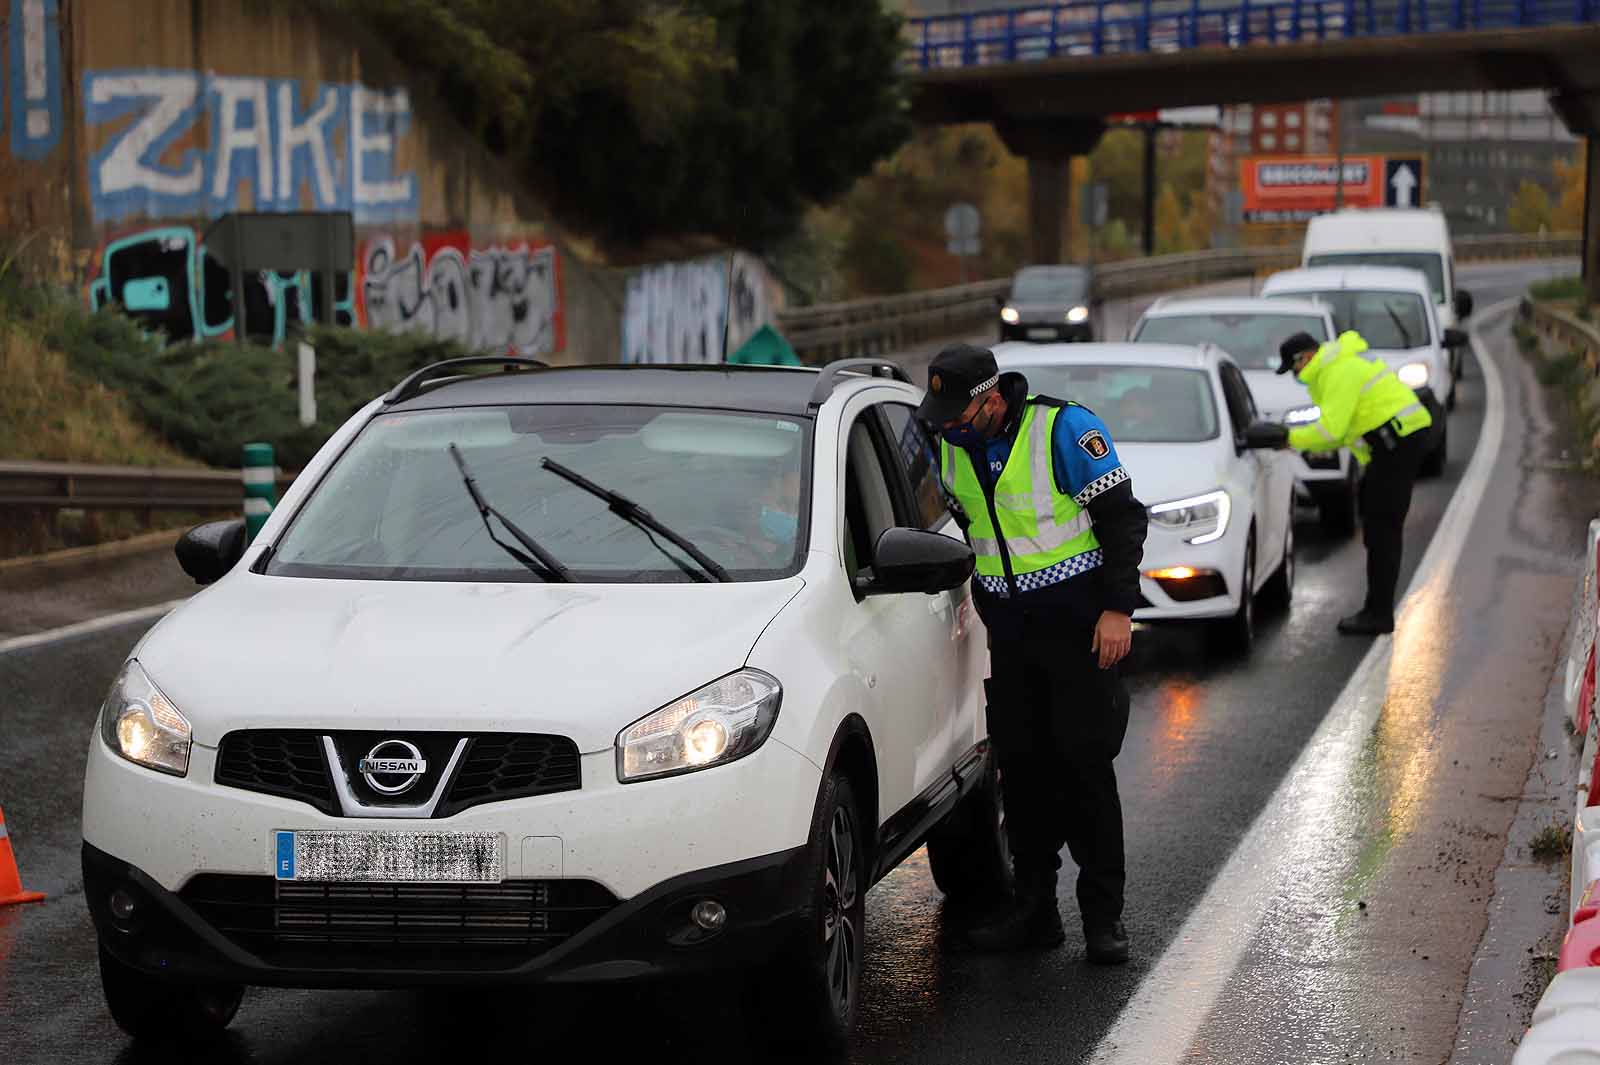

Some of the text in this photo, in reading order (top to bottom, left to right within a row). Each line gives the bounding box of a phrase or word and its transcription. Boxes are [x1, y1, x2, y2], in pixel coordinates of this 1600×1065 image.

[89, 71, 413, 208] ZAKE
[365, 761, 418, 771] NISSAN
[281, 859, 289, 871] E
